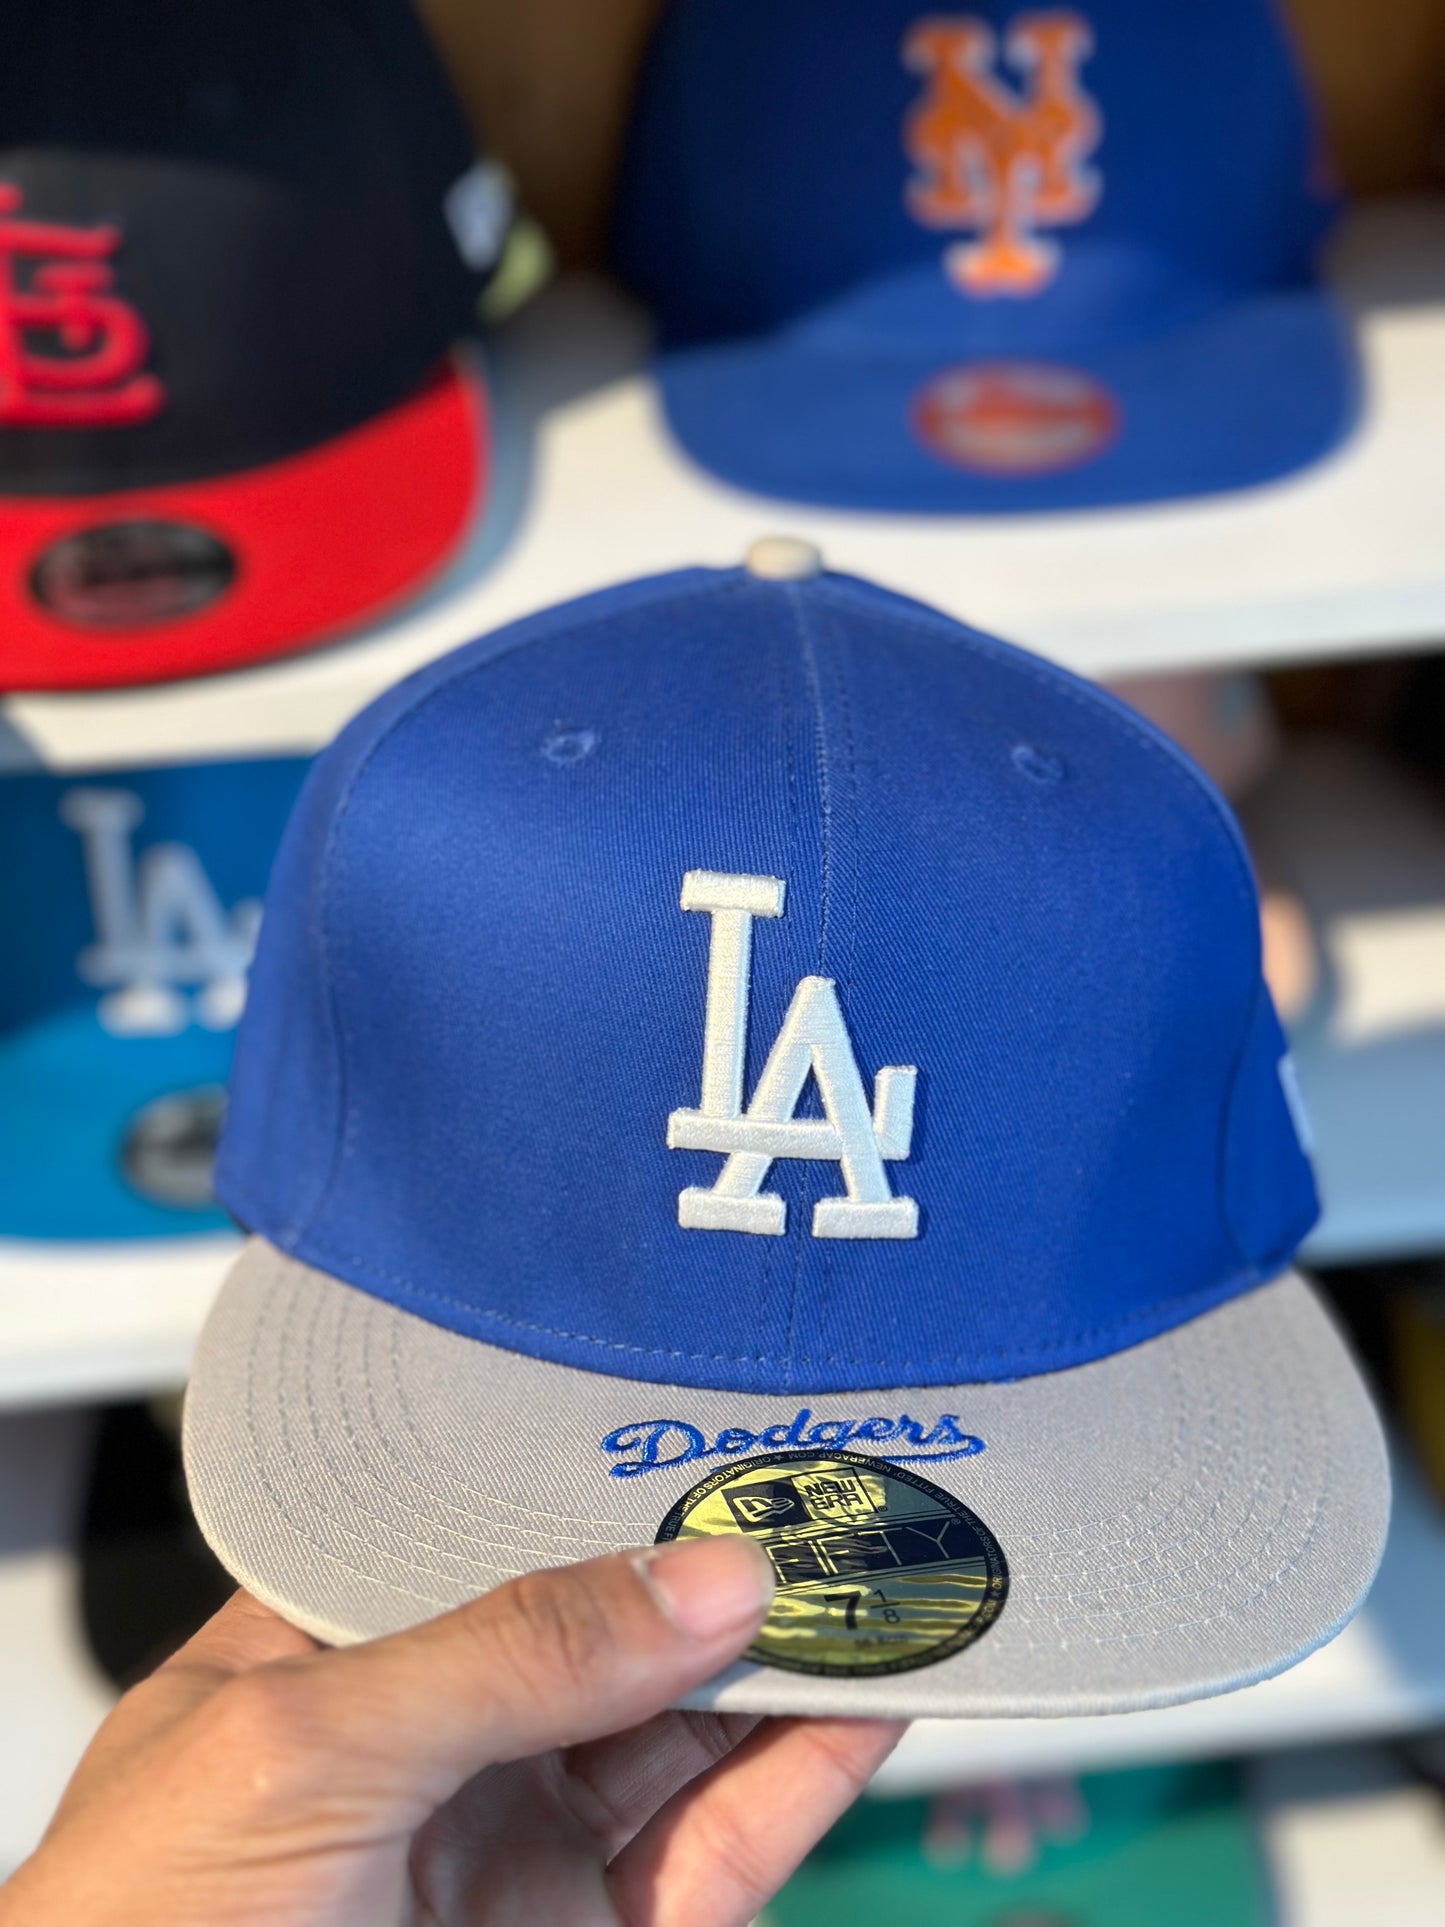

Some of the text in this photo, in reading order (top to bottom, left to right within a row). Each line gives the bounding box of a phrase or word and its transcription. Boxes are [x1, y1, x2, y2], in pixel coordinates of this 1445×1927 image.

[667, 869, 919, 1239] LA
[601, 1409, 986, 1478] Dodgers
[703, 1455, 772, 1490] ORIGINATORS
[803, 1479, 857, 1498] NEW
[810, 1492, 864, 1511] ERA
[824, 1590, 862, 1630] 7
